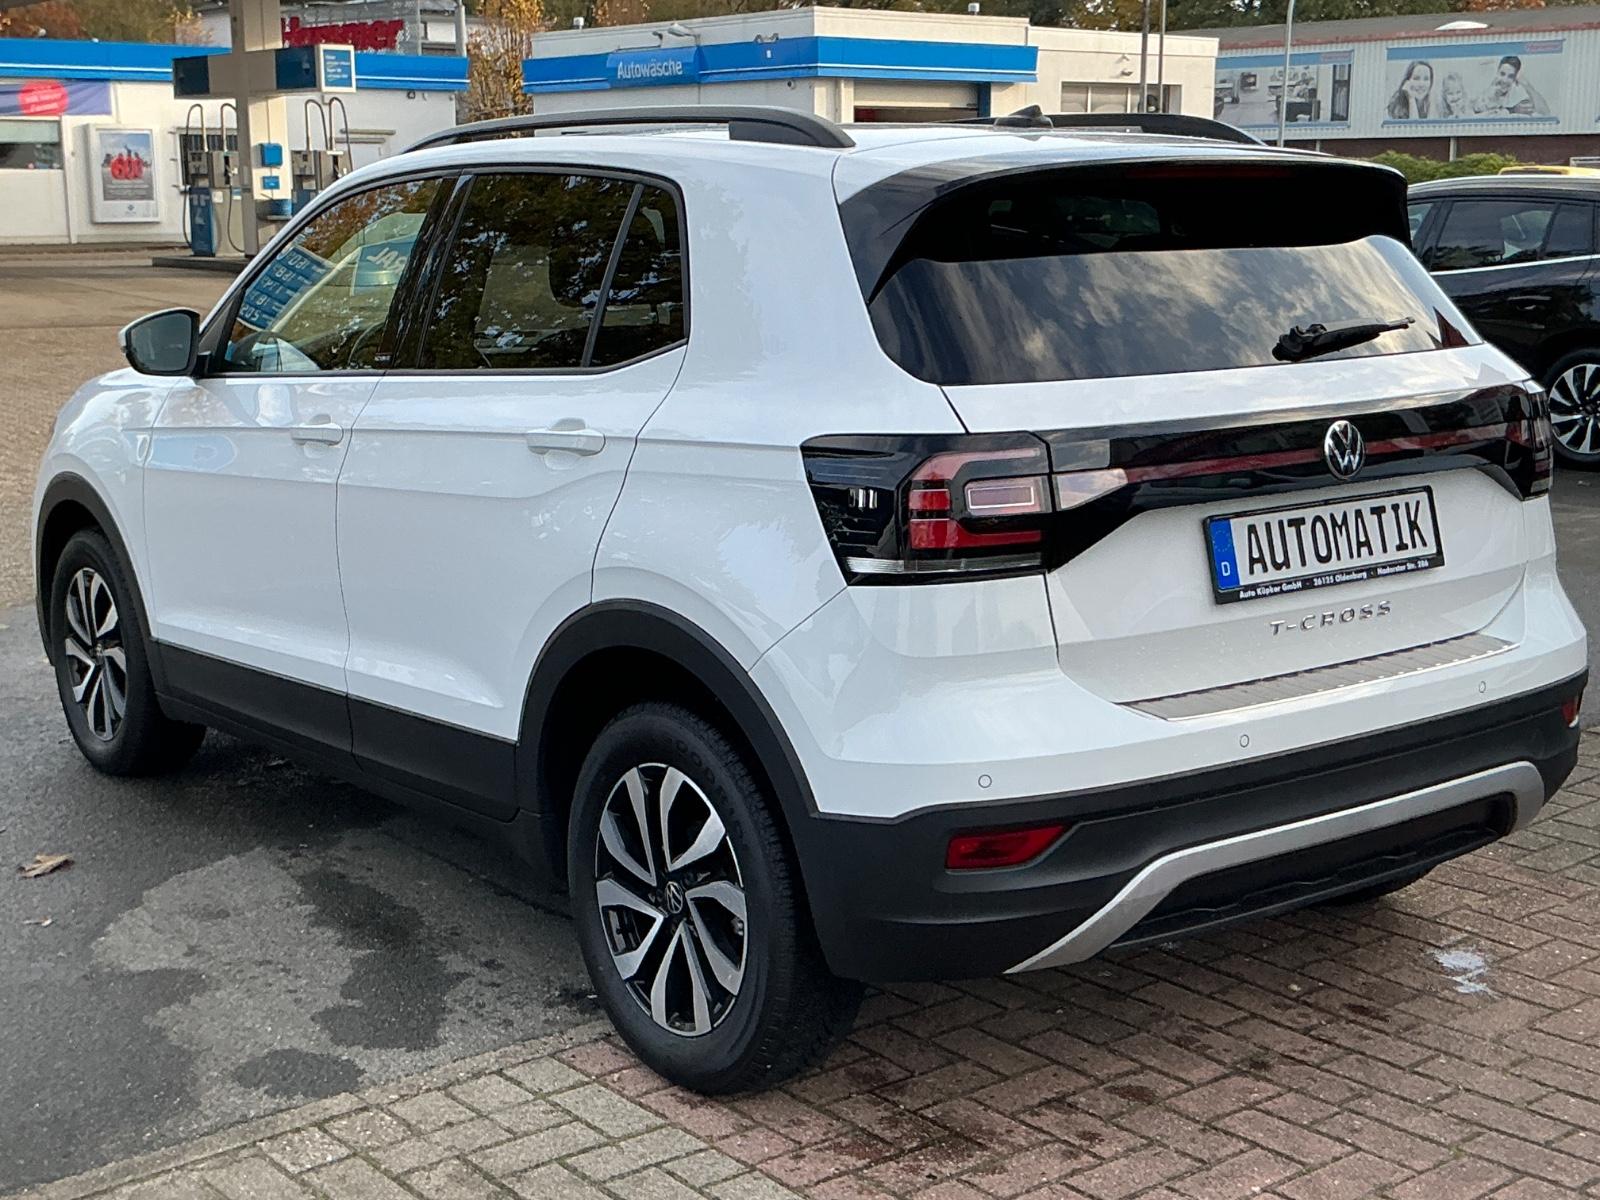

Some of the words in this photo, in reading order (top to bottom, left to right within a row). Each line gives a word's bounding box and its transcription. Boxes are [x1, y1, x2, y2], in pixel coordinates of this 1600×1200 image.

[617, 58, 683, 79] Autowäsche
[1248, 500, 1427, 575] AUTOMATIK
[1221, 561, 1231, 577] D
[1239, 589, 1256, 599] Auto
[1281, 581, 1303, 591] GmbH
[1313, 575, 1335, 587] 26125
[1335, 571, 1367, 583] Oldenburg
[1270, 600, 1392, 636] T-CROSS
